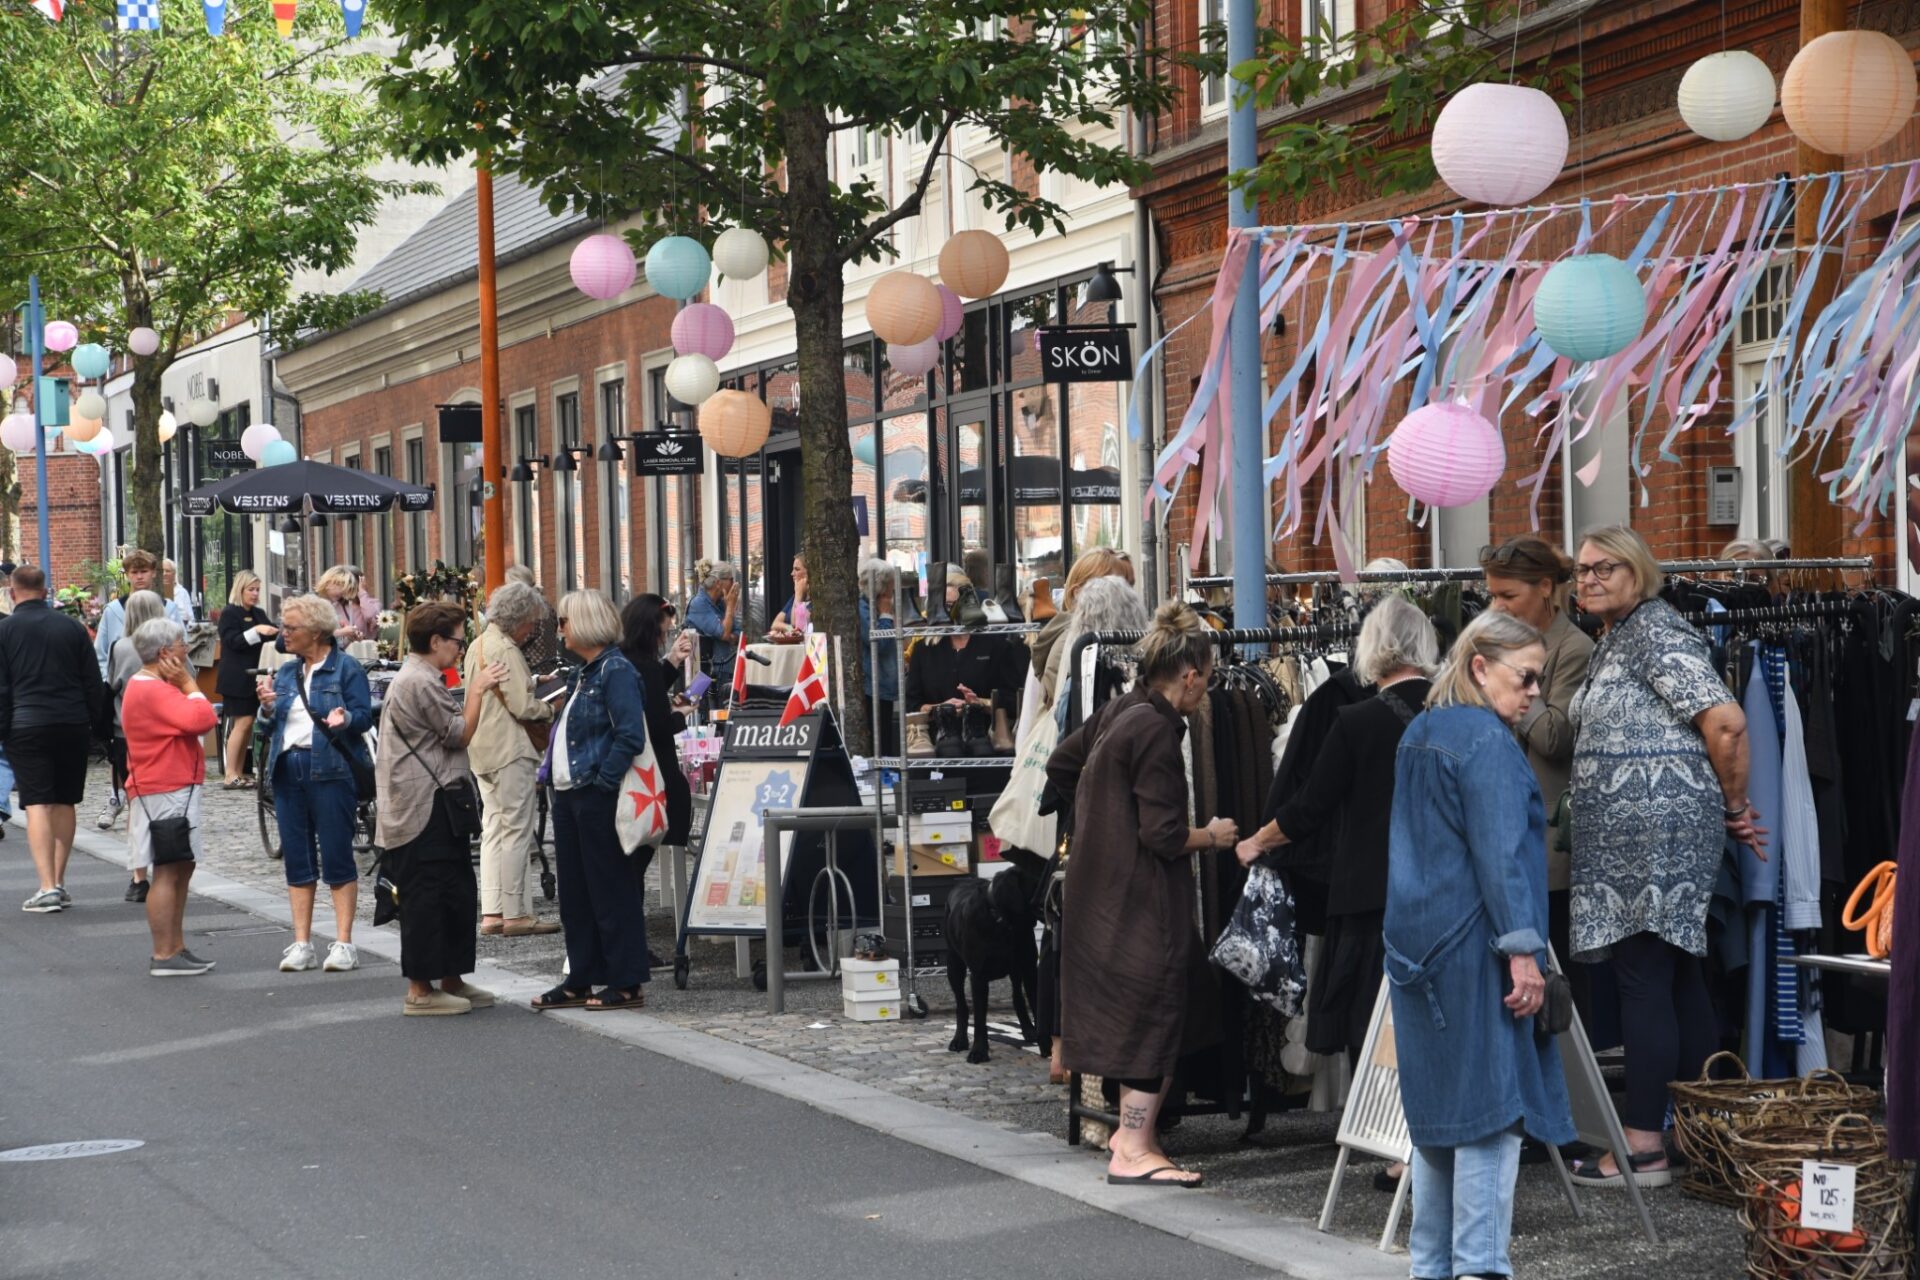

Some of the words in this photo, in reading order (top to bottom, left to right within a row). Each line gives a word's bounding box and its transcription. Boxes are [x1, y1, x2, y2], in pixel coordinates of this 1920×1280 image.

[1051, 340, 1120, 368] SKÖN
[187, 371, 205, 400] NOBEL
[233, 495, 289, 507] VESTENS
[325, 494, 381, 506] VESTENS
[733, 724, 810, 747] matas
[761, 784, 772, 804] 3
[778, 784, 789, 804] 2
[1813, 1173, 1826, 1185] NU
